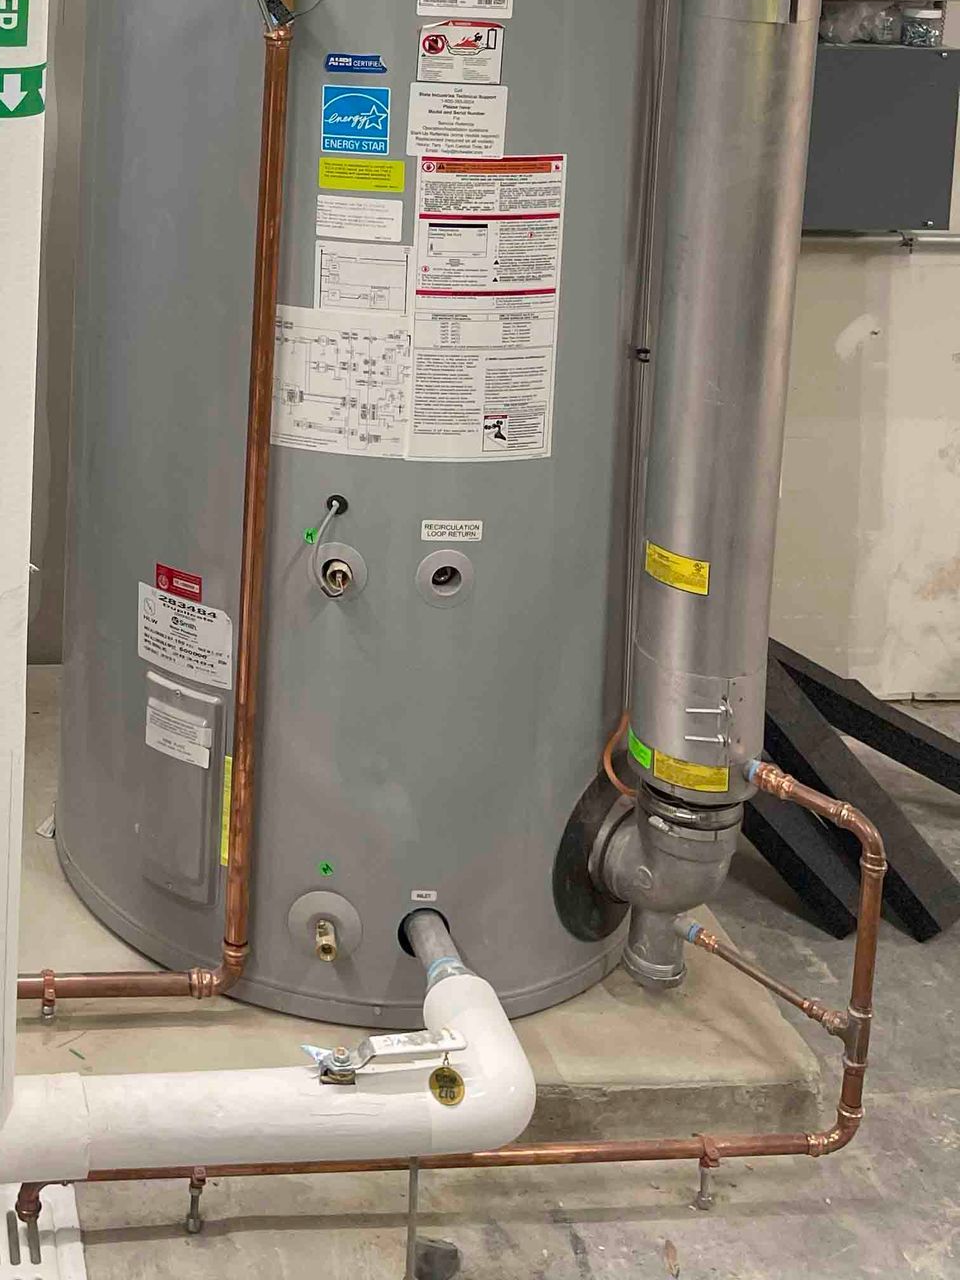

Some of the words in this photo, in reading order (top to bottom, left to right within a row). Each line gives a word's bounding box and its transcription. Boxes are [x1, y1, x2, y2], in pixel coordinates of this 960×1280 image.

[329, 113, 368, 129] energy
[325, 139, 360, 150] ENERGY
[362, 140, 385, 151] STAR
[159, 595, 216, 618] 283484
[180, 620, 197, 630] Smith
